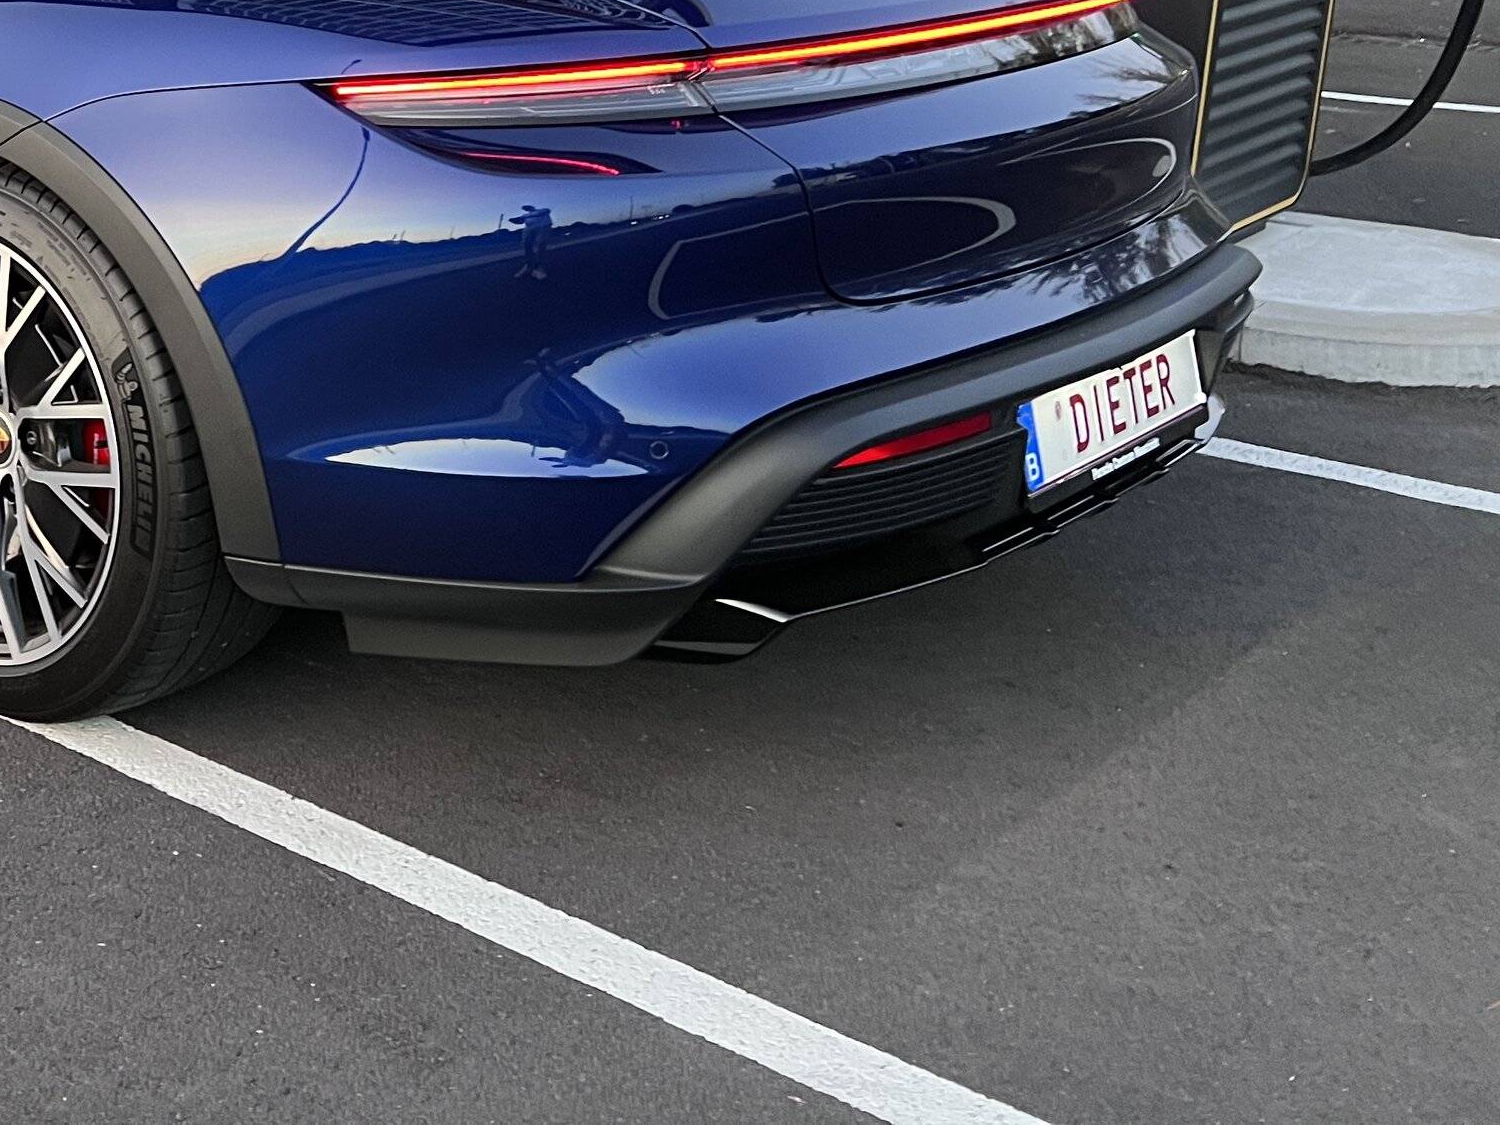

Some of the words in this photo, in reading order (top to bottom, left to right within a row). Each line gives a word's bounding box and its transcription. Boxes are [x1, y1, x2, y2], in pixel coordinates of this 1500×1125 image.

[1069, 353, 1176, 454] DIETER
[126, 404, 154, 552] MICHELIN
[1025, 452, 1040, 483] B
